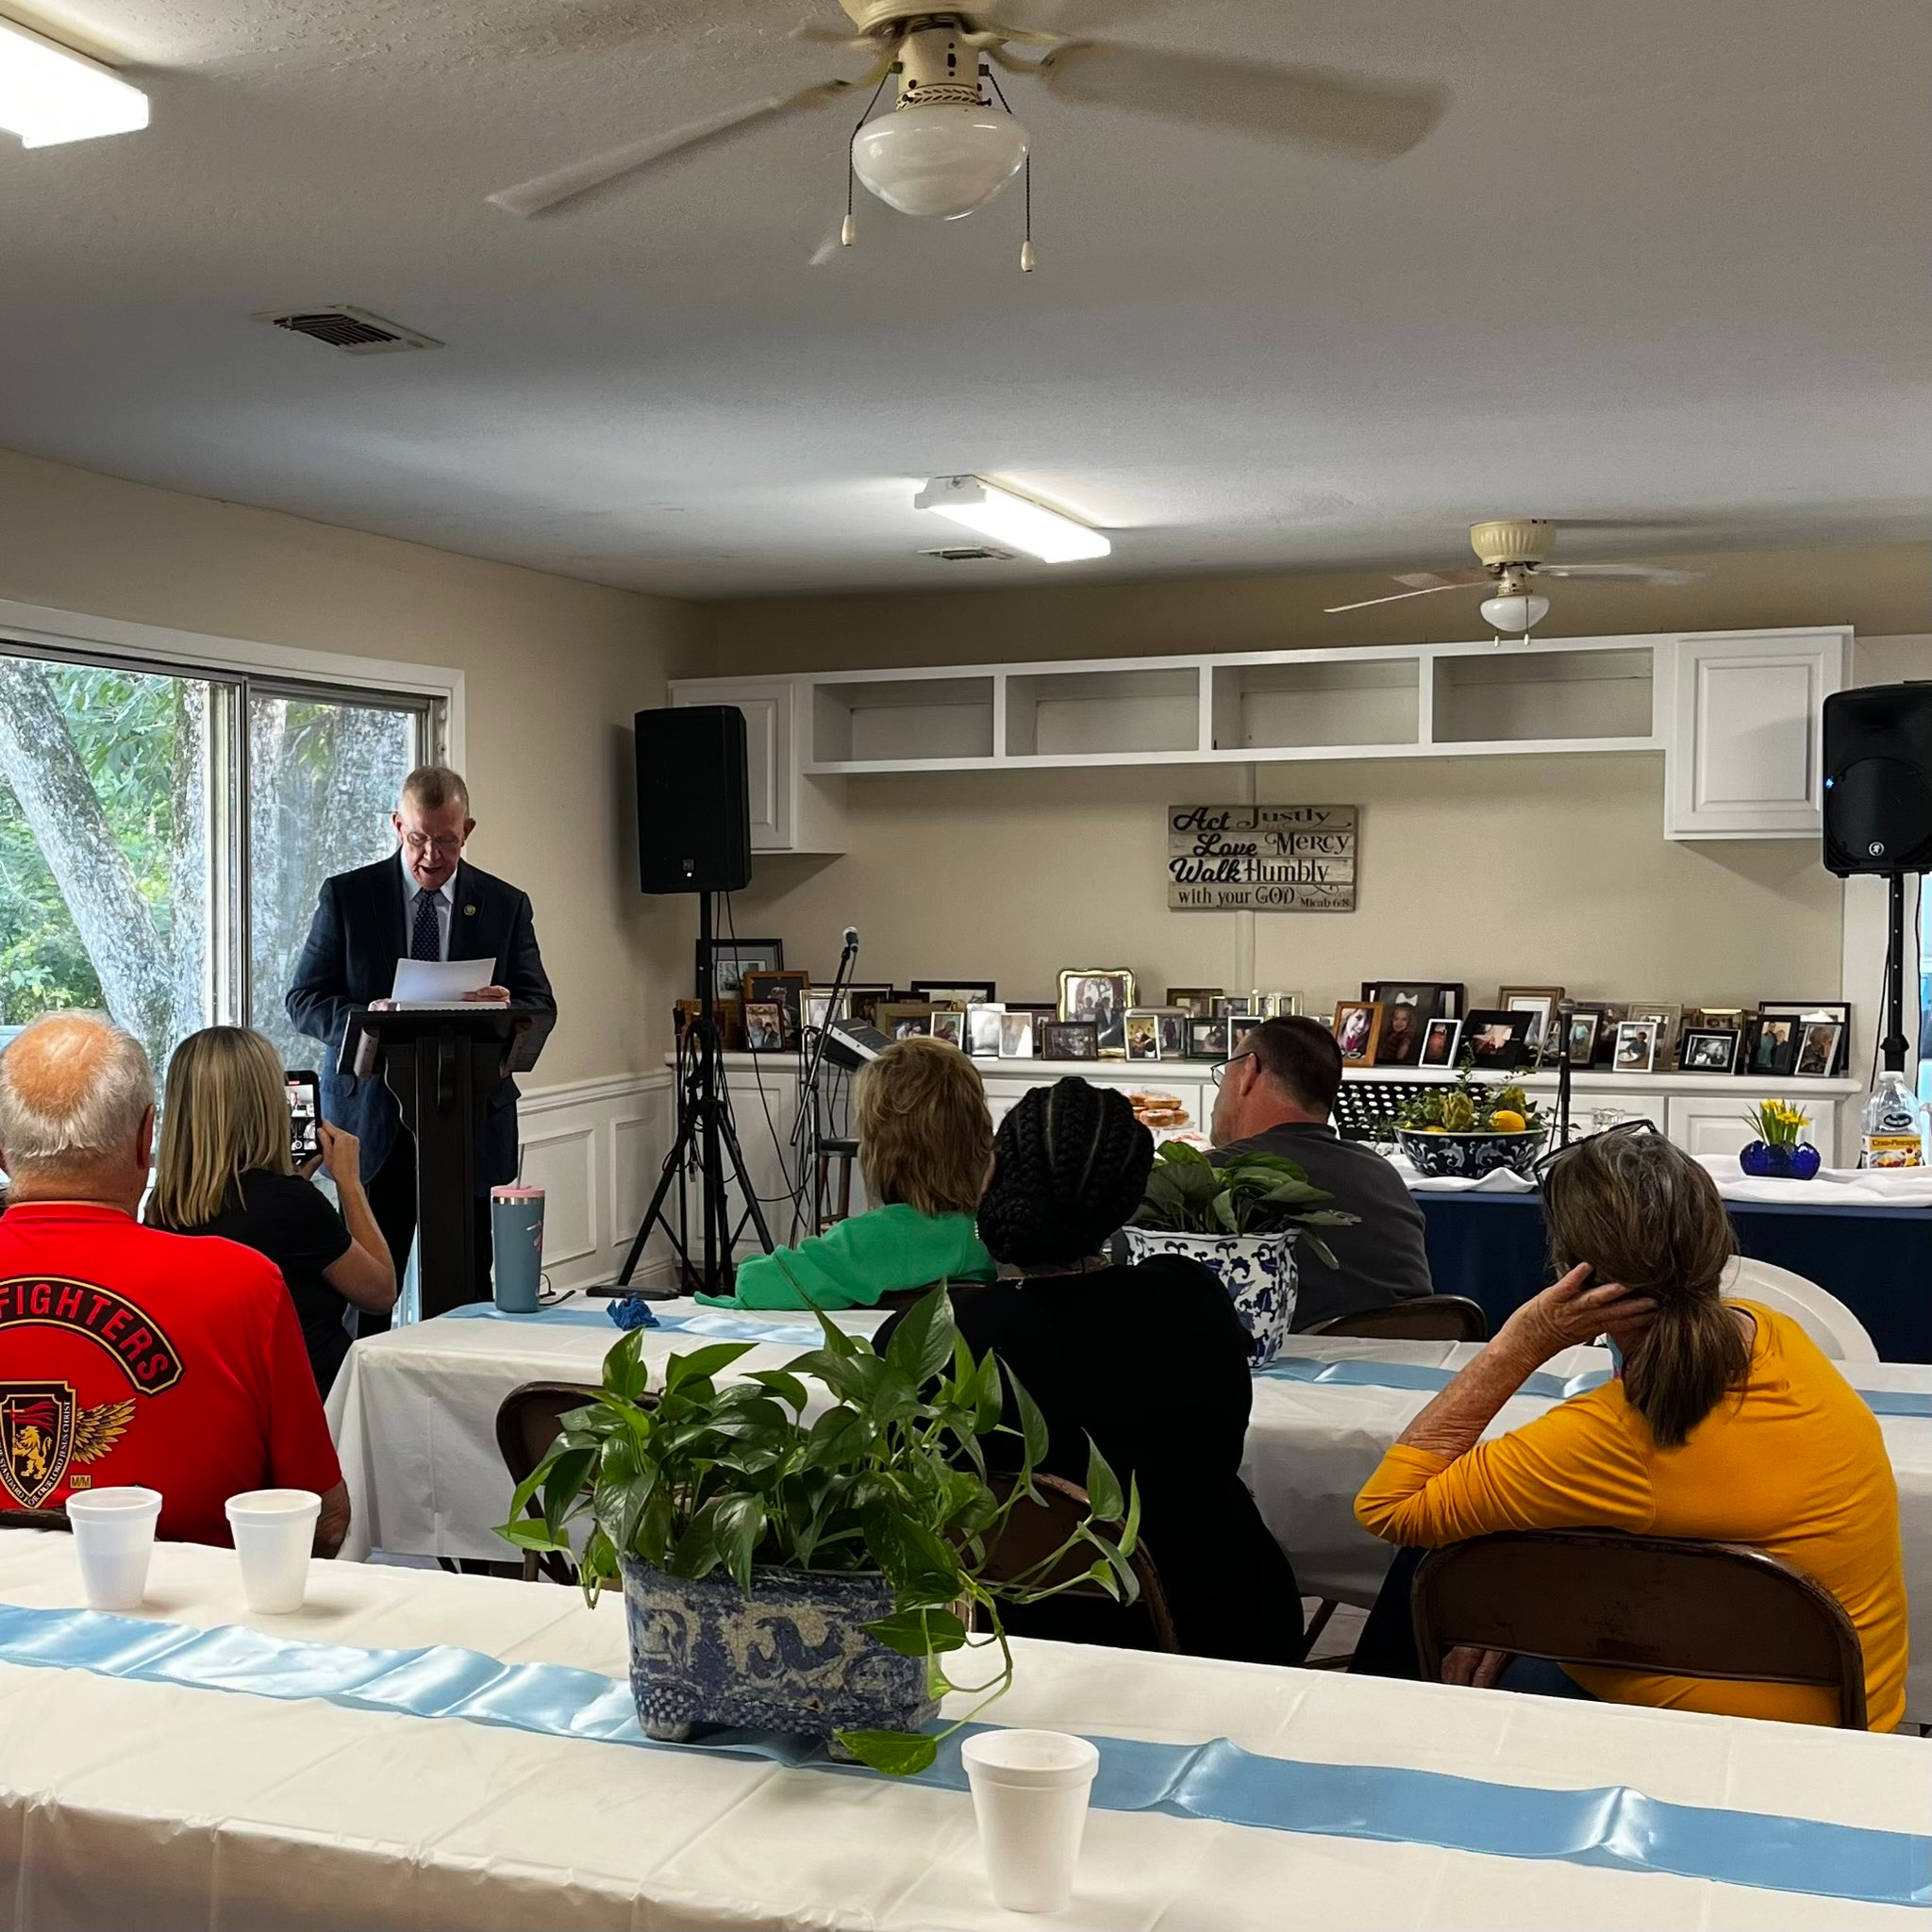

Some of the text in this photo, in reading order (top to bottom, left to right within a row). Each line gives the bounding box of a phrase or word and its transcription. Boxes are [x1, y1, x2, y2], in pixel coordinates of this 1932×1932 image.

[1173, 807, 1352, 830] Act Justly
[1192, 832, 1350, 857] Love Mercy
[1169, 858, 1330, 884] Walk Humbly
[1179, 887, 1212, 905] with
[1217, 890, 1252, 909] your
[1255, 886, 1295, 905] GOD
[1300, 897, 1331, 908] Micah
[0, 1401, 71, 1507] STANDARD FOR OUR LORD JESUS CHRIST
